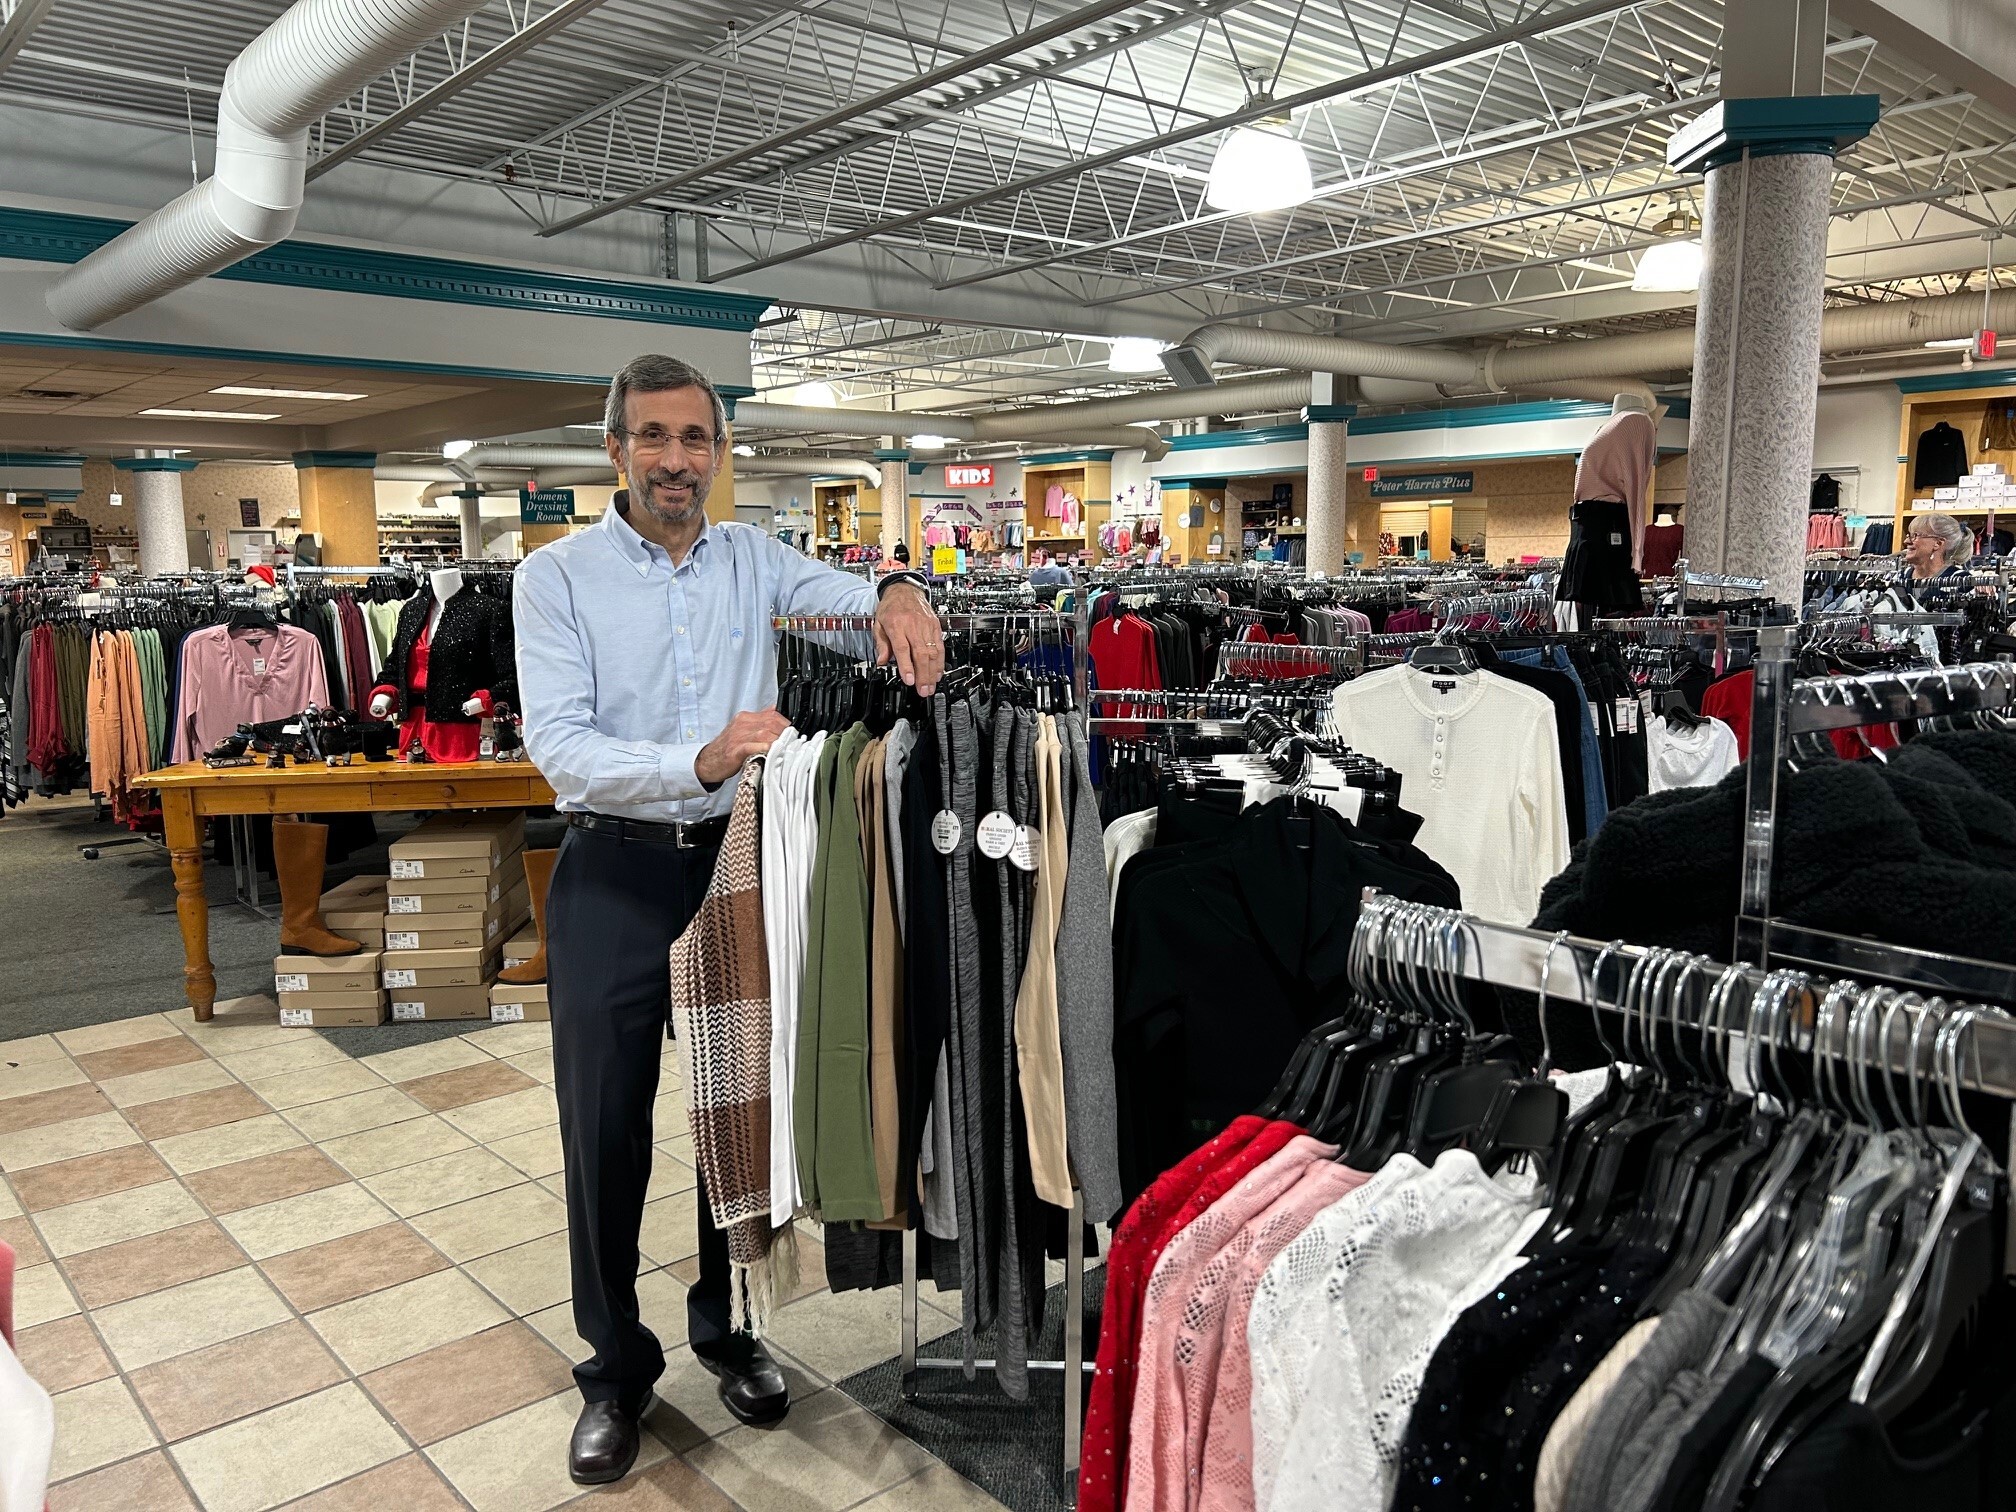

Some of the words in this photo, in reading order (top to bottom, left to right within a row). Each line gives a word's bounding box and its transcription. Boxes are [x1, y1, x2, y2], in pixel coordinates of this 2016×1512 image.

[949, 468, 991, 485] KIDS
[1373, 481, 1402, 492] Peter
[1404, 479, 1441, 490] Harris
[1442, 477, 1471, 488] Plus
[529, 491, 567, 501] Womens
[526, 501, 568, 512] Dressing
[536, 511, 562, 521] Room
